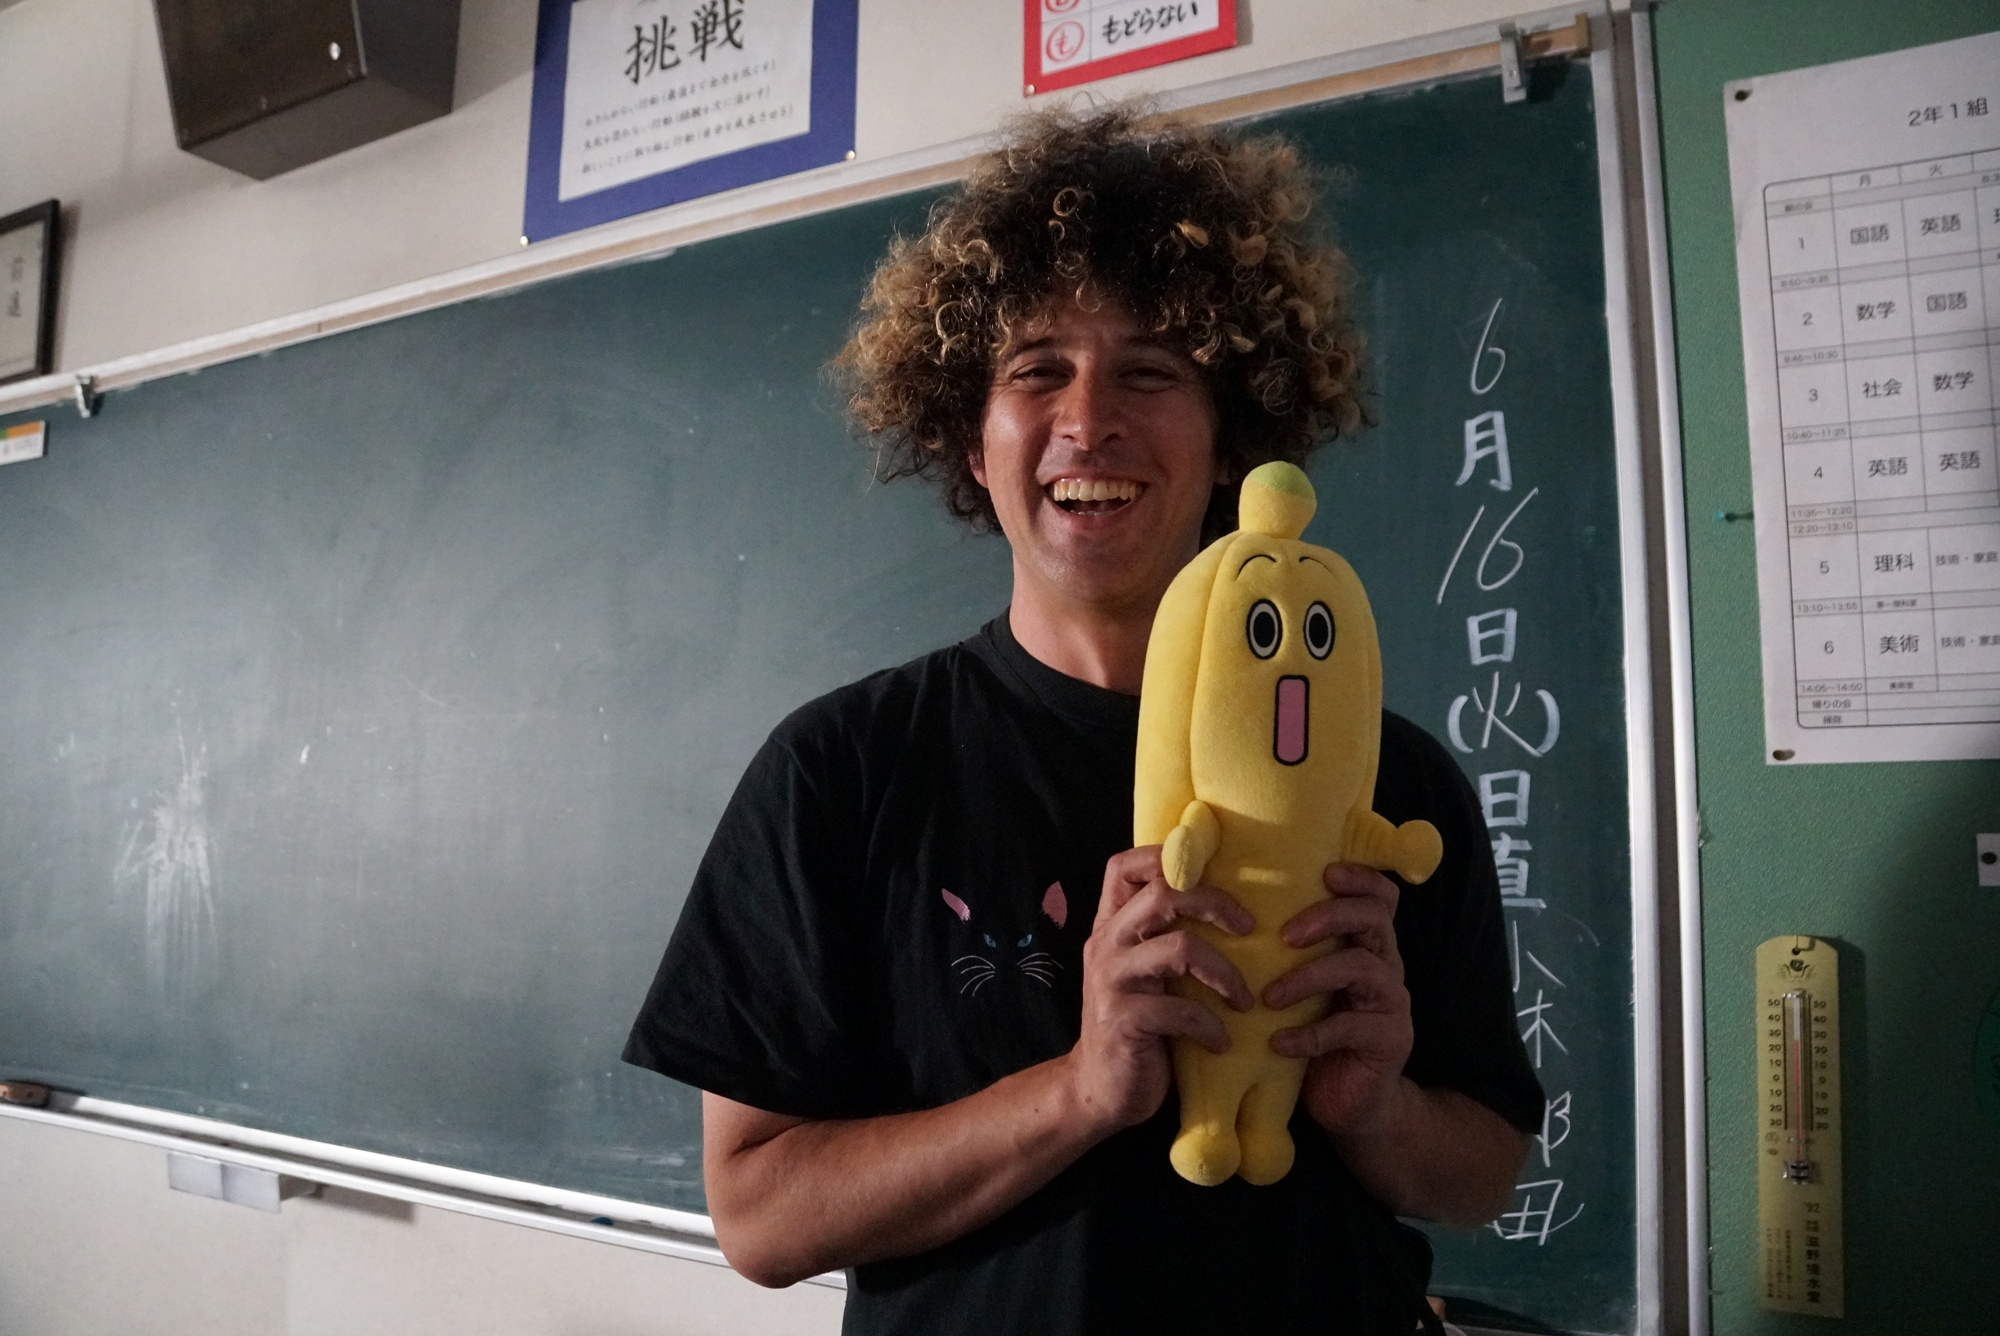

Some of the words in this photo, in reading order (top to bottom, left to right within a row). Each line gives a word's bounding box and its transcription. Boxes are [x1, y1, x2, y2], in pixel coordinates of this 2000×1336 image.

[1102, 2, 1198, 45] もどらない
[624, 0, 744, 84] 挑戦
[1859, 174, 1871, 186] 月
[1930, 165, 1943, 176] 火
[1799, 238, 1804, 249] 1
[1851, 224, 1889, 244] 国語
[1921, 214, 1960, 235] 英語
[1803, 313, 1812, 325] 2
[1857, 302, 1895, 321] 数学
[1927, 292, 1967, 312] 国語
[1809, 389, 1818, 401] 3
[1863, 378, 1902, 398] 社会
[1934, 371, 1974, 391] 数学
[1813, 466, 1823, 478] 4
[1868, 457, 1908, 477] 英語
[1939, 451, 1980, 471] 英語
[1820, 561, 1829, 574] 5
[1874, 553, 1914, 573] 理科
[1824, 640, 1834, 653] 6
[1880, 634, 1919, 653] 美術
[1768, 999, 1781, 1007] 50
[1813, 1001, 1827, 1009] 50
[1768, 1014, 1781, 1022] 40
[1813, 1015, 1827, 1023] 40
[1769, 1029, 1782, 1037] 30
[1814, 1031, 1827, 1039] 30
[1769, 1044, 1782, 1052] 20
[1814, 1046, 1827, 1054] 20
[1769, 1059, 1782, 1067] 10
[1815, 1061, 1827, 1069] 10
[1773, 1074, 1780, 1082] 0
[1819, 1076, 1826, 1084] 0
[1769, 1089, 1782, 1097] 10
[1815, 1092, 1828, 1100] 10
[1769, 1104, 1782, 1112] 20
[1815, 1107, 1829, 1115] 20
[1769, 1118, 1782, 1127] 30
[1815, 1122, 1829, 1130] 30
